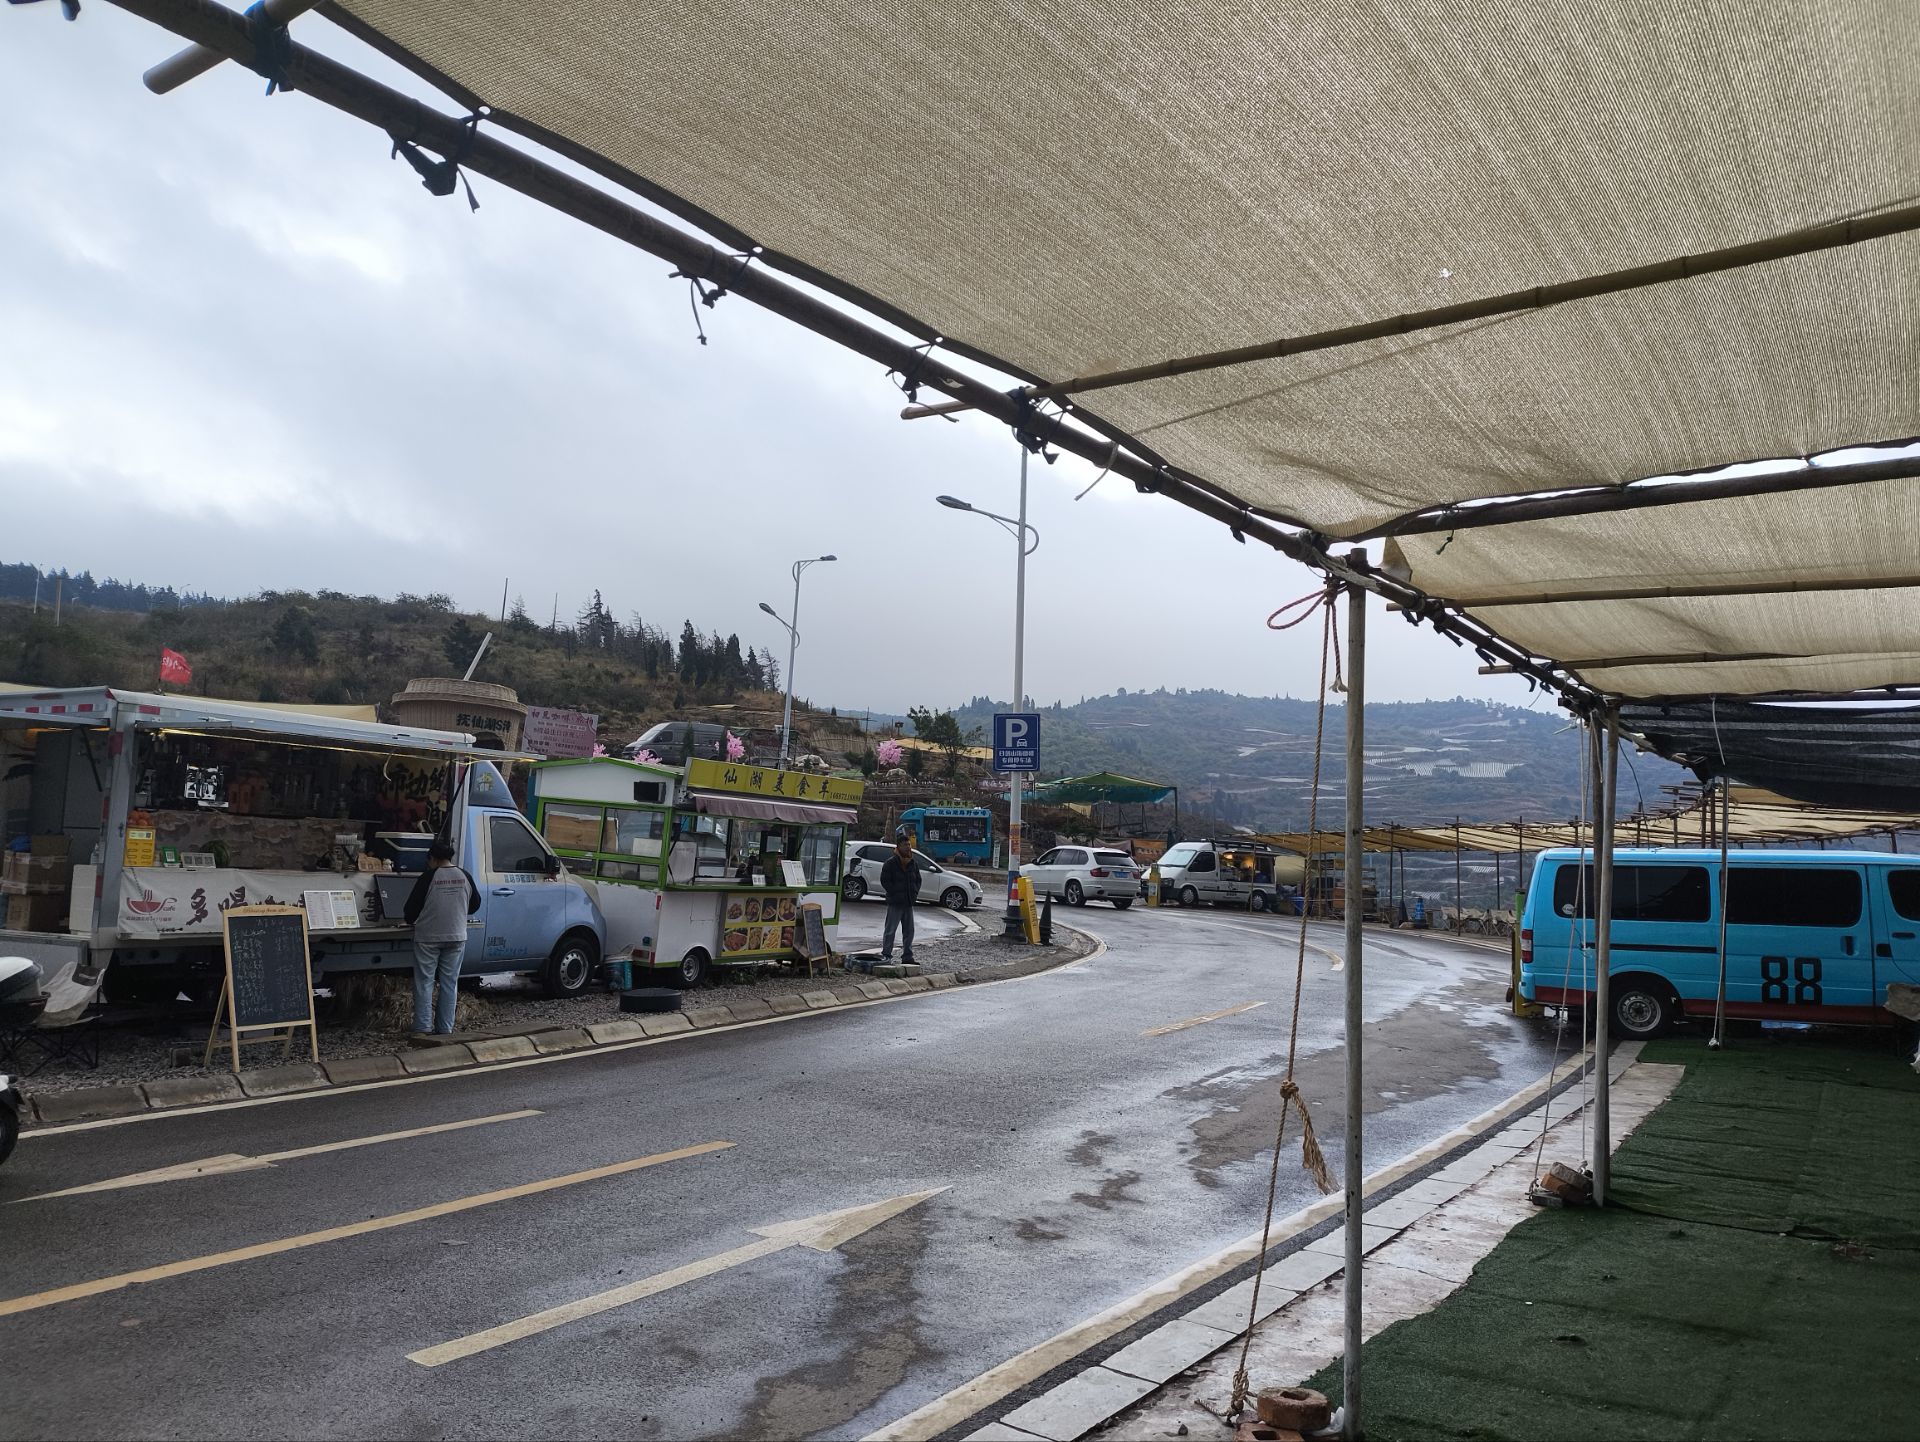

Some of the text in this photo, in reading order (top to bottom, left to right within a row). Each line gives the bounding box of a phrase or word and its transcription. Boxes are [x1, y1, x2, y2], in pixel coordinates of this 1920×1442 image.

[1005, 718, 1029, 748] P
[724, 768, 830, 800] 仙湖美食车
[1761, 956, 1823, 1005] 88
